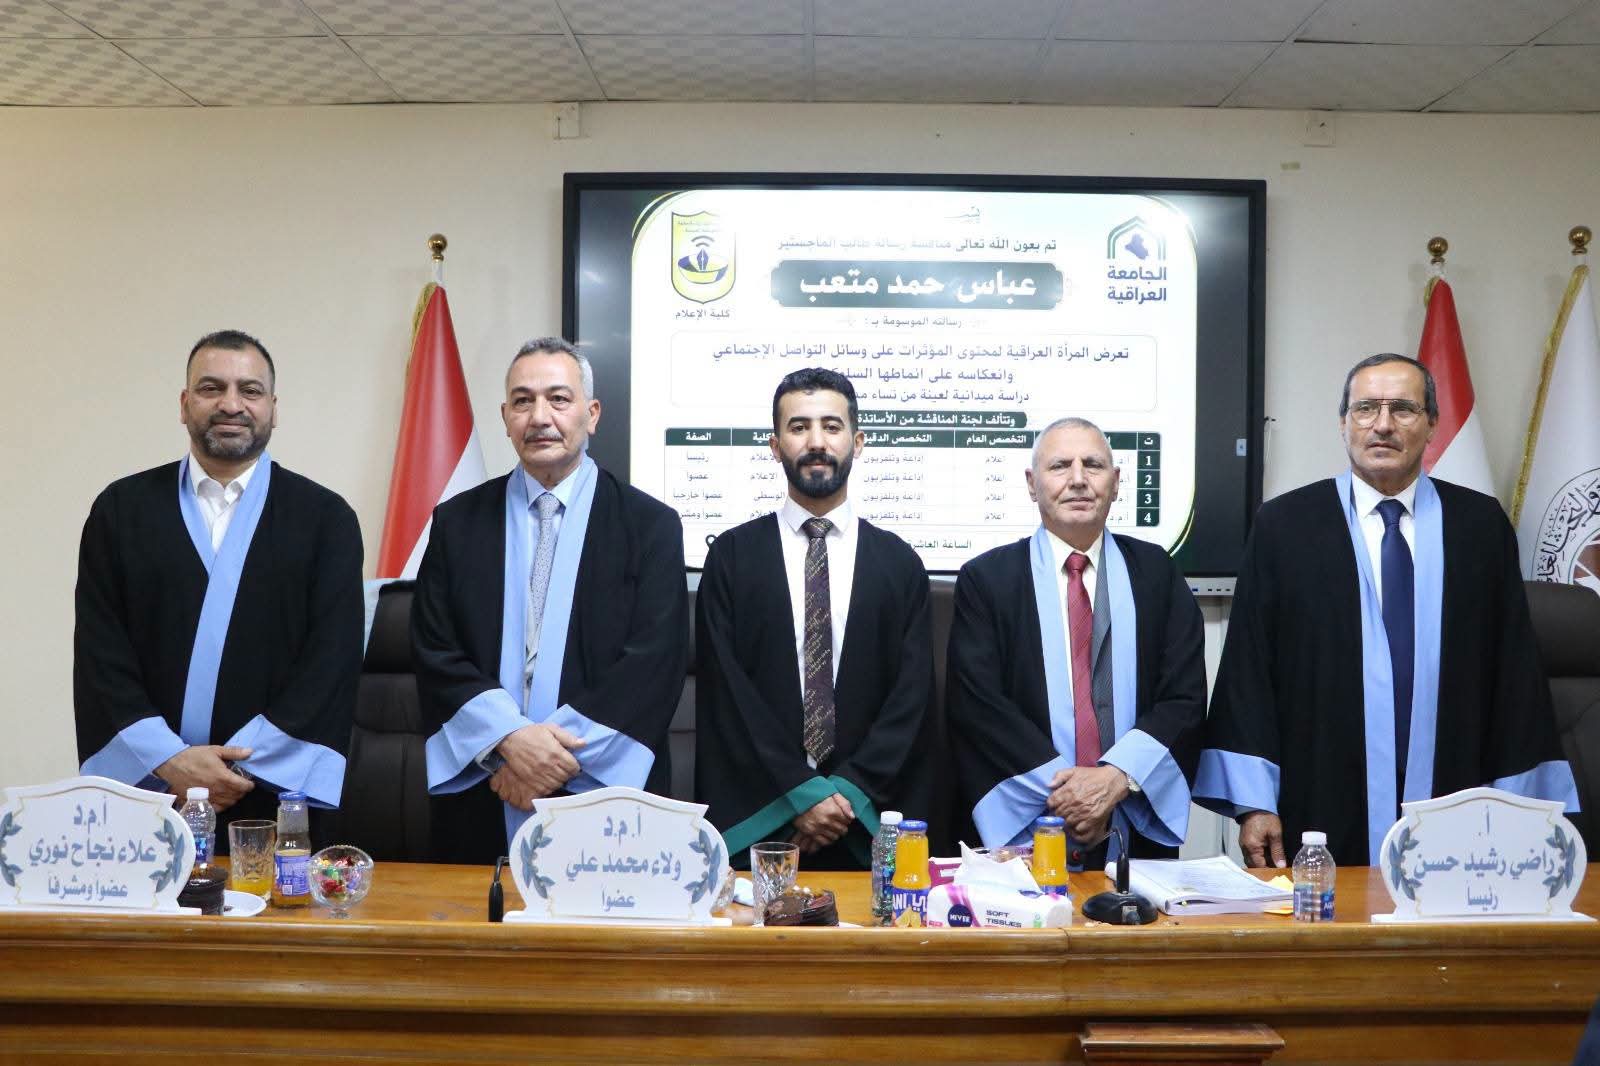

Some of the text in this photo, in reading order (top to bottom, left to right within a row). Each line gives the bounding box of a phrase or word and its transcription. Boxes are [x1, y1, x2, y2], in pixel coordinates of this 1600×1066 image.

[989, 236, 1009, 249] الله
[1013, 240, 1040, 253] بعون
[1044, 239, 1057, 254] تم
[1107, 265, 1167, 284] الجامعة
[800, 268, 1037, 304] عباس حمد متعب
[1107, 286, 1167, 304] العراقية
[710, 307, 730, 320] كلية
[883, 316, 929, 327] الموسومة
[780, 344, 826, 358] التواصل
[831, 344, 867, 358] وسائل
[872, 344, 894, 359] على
[899, 344, 952, 359] المؤثرات
[957, 346, 1002, 359] لمحتوى
[1007, 345, 1052, 360] العراقية
[1057, 343, 1089, 361] المرأة
[1094, 347, 1129, 361] تعرض
[929, 368, 952, 383] على
[958, 368, 1014, 383] وانعكاسه
[872, 389, 896, 399] نساء
[901, 392, 916, 402] من
[920, 389, 949, 403] لعينة
[952, 389, 993, 403] ميدانية
[998, 390, 1029, 403] دراسة
[858, 411, 896, 423] الأساتذة
[899, 415, 915, 426] من
[917, 411, 958, 424] المناقشة
[961, 411, 982, 427] لجنة
[685, 432, 712, 441] الصفة
[891, 433, 932, 444] التخصص
[966, 434, 1027, 446] التخصص العام
[1146, 455, 1152, 466] 1
[1145, 474, 1152, 485] 2
[1145, 493, 1152, 504] 3
[1144, 512, 1152, 523] 4
[942, 539, 972, 549] الساعة
[29, 834, 157, 868] علاء نجاح نوري
[566, 849, 681, 882] ولاء محمد علي
[1414, 847, 1556, 880] راضي رشيد حسن
[986, 910, 1010, 918] SOFT
[985, 918, 1022, 928] TISSUES
